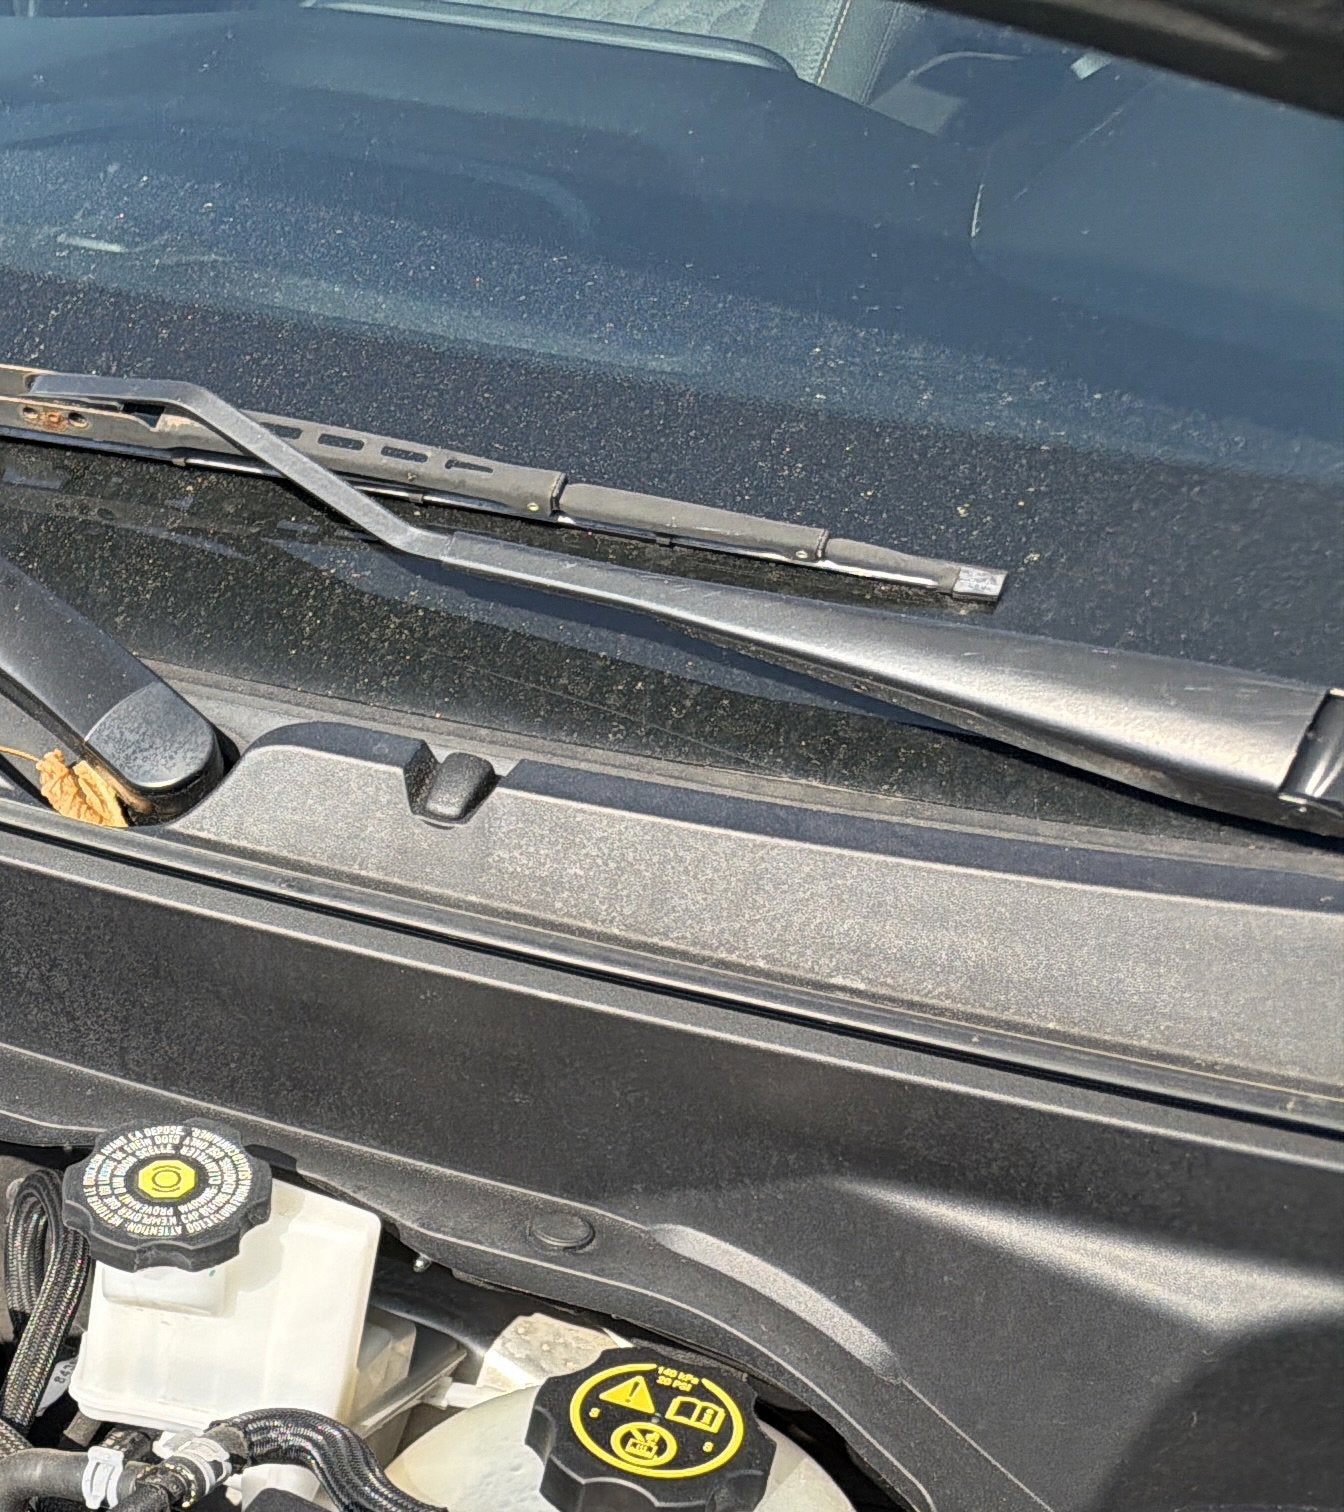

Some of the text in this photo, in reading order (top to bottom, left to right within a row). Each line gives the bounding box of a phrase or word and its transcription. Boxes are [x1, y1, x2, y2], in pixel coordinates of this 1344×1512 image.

[181, 1211, 200, 1223] CAP
[125, 1220, 182, 1235] ATTENTION:
[657, 1376, 672, 1387] 20
